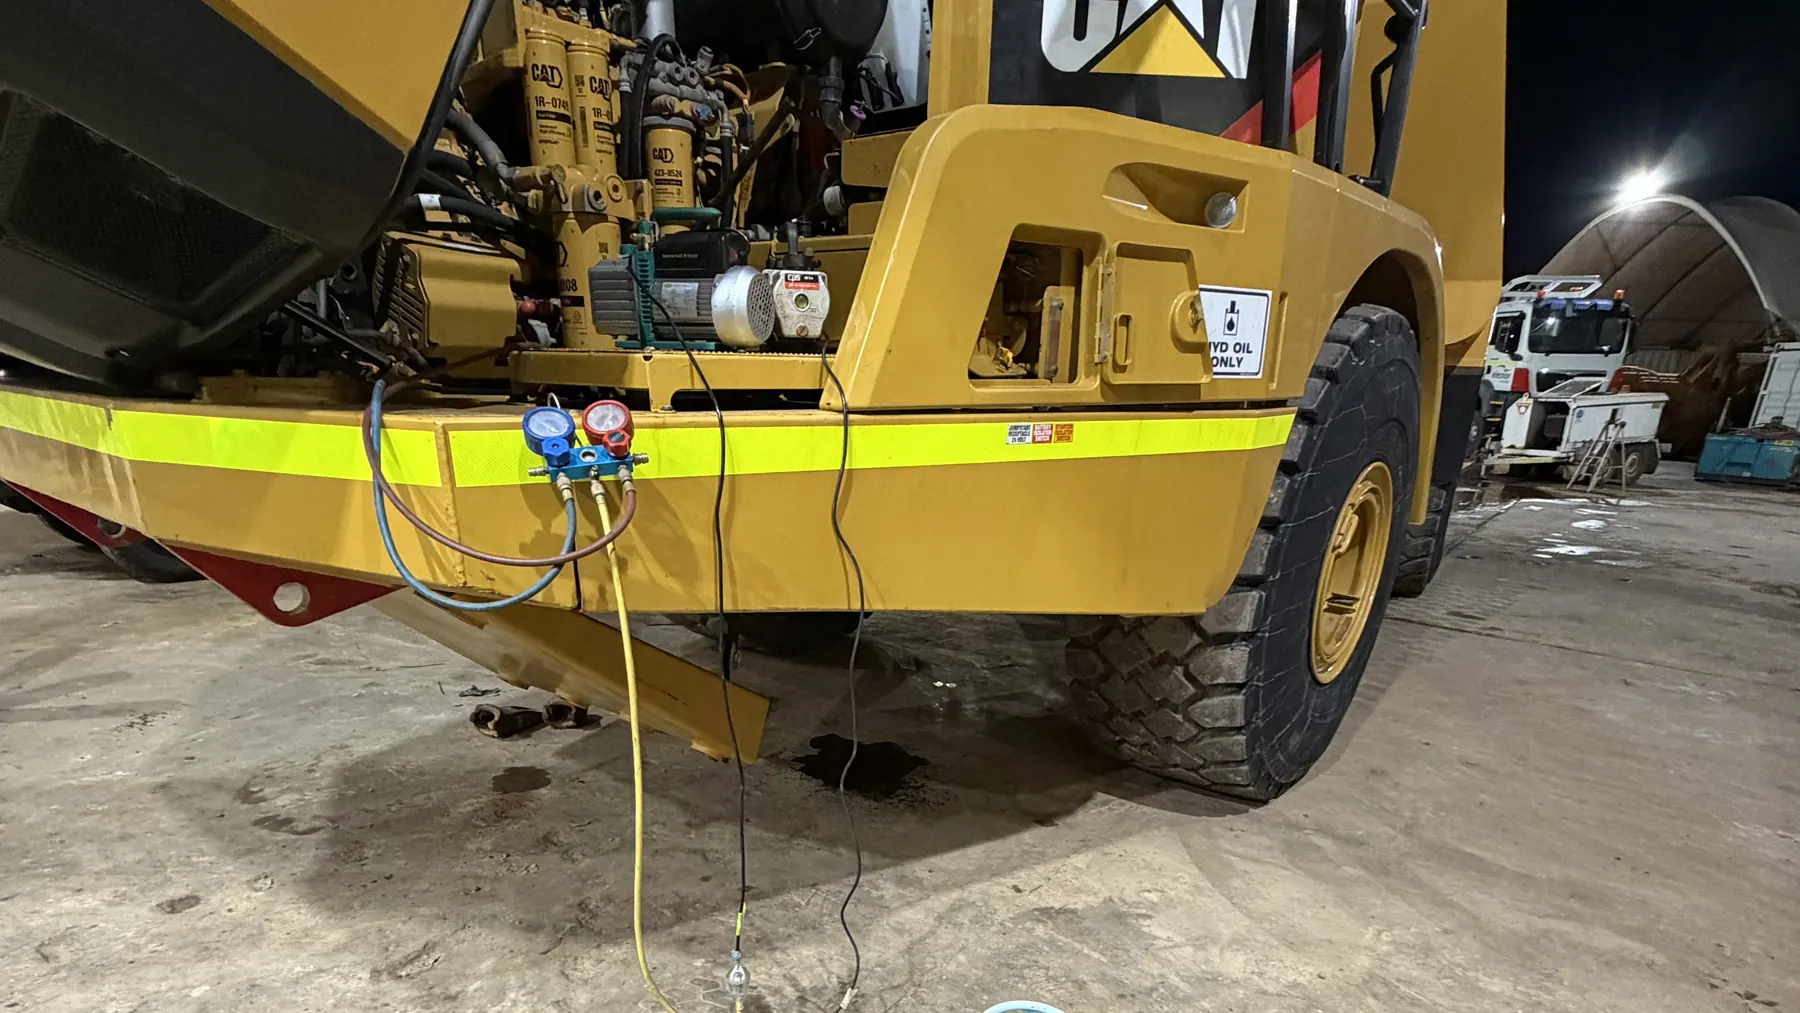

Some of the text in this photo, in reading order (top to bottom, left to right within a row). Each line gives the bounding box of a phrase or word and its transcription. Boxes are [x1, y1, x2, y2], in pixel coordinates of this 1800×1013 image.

[531, 63, 563, 89] CAT
[652, 147, 674, 163] CAT
[1233, 342, 1253, 354] OIL
[1211, 356, 1244, 368] ONLY
